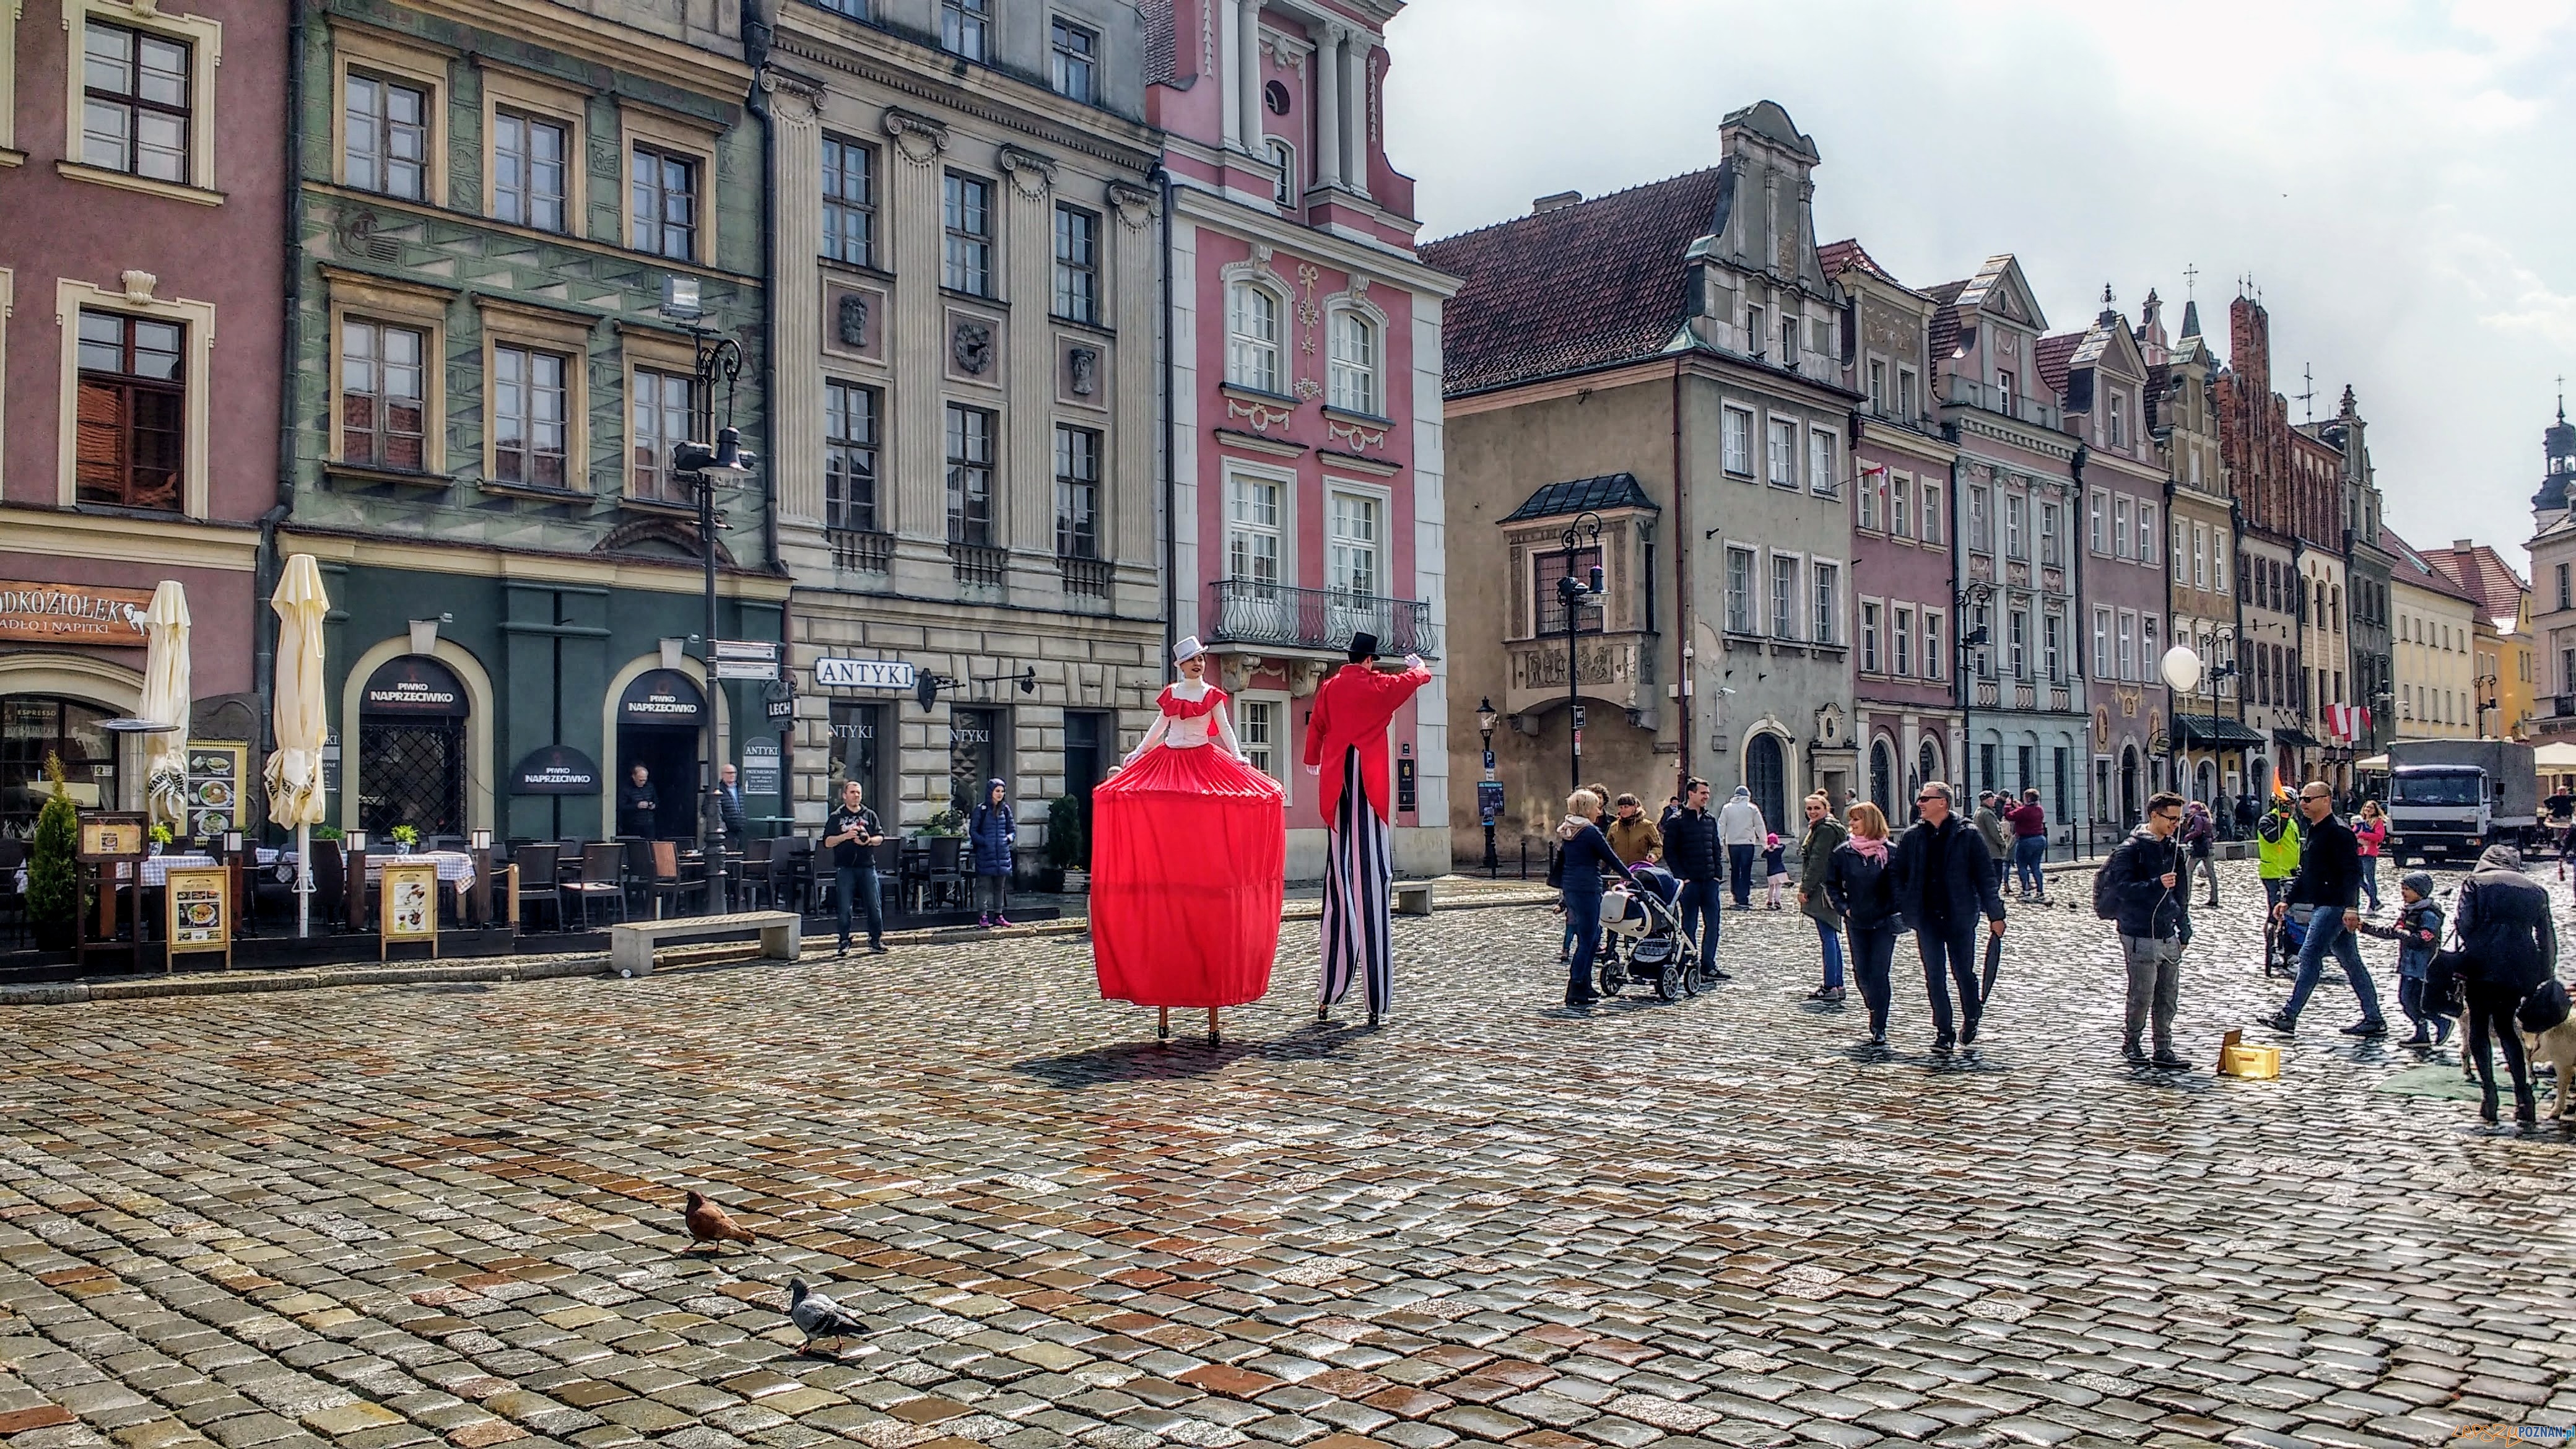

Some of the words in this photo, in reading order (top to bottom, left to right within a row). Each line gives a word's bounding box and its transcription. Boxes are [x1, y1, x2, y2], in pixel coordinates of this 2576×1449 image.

[0, 591, 123, 624] DKOZIOŁEK
[51, 622, 108, 633] NAPITKI
[822, 663, 910, 684] ANTYKI
[370, 691, 454, 702] NAPRZECIWKO
[628, 702, 697, 713] NAPRZECIWKO
[768, 701, 791, 716] LECH
[746, 746, 778, 755] ANTYKI
[1486, 752, 1492, 763] P
[524, 774, 591, 783] NAPRZECIWKO
